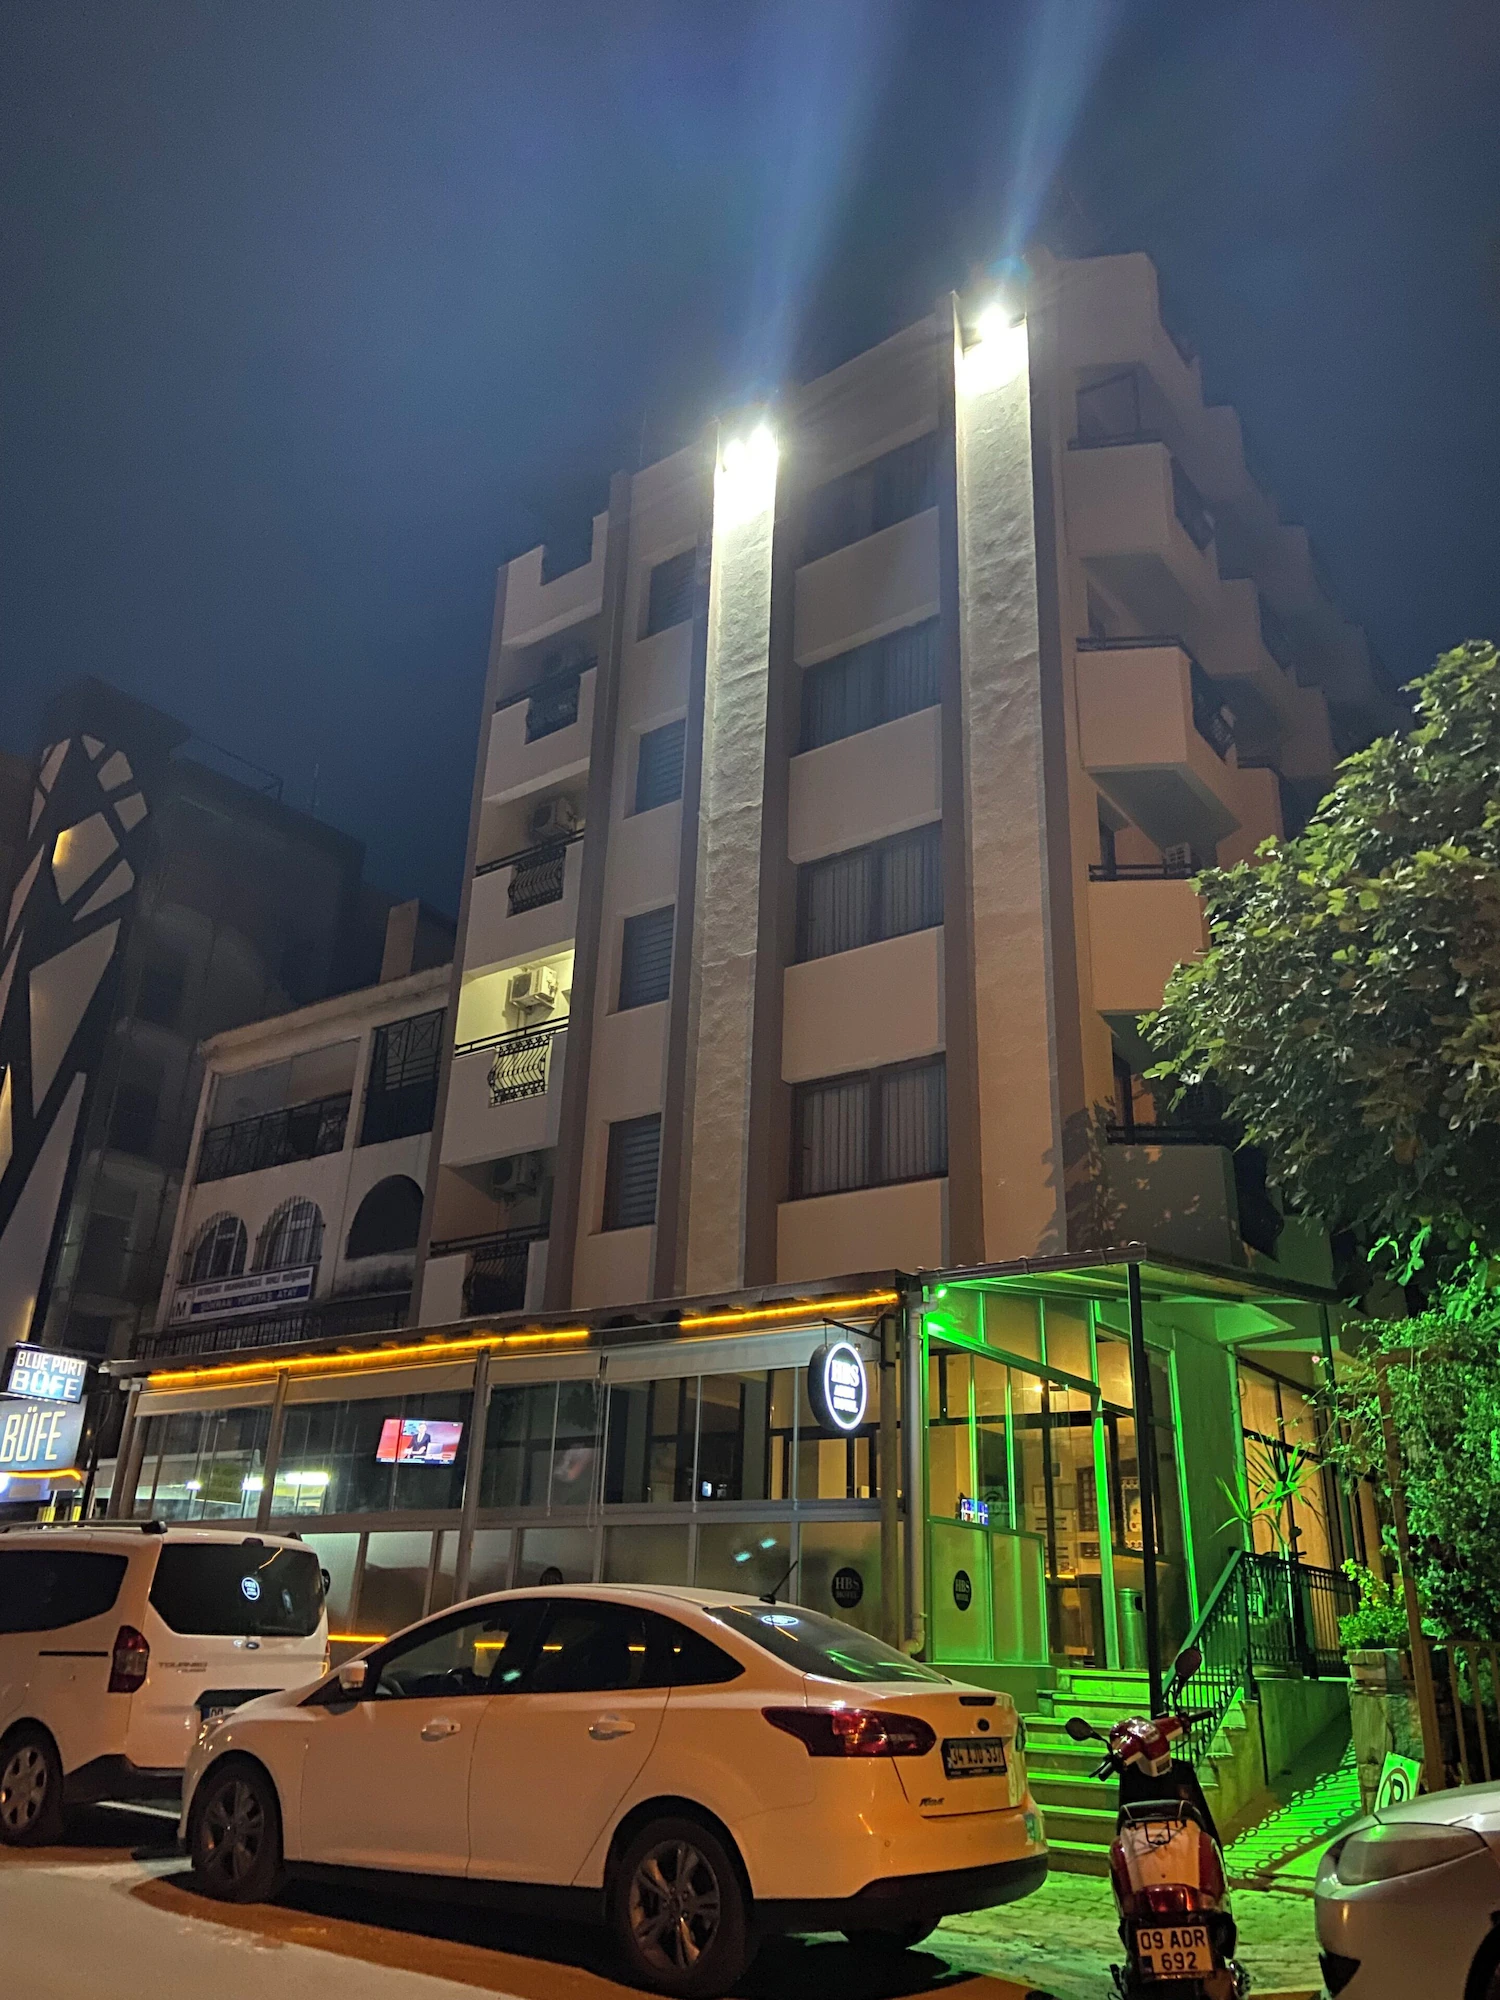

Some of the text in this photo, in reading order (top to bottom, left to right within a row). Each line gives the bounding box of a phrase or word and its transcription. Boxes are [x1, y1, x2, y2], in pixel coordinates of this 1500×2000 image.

[16, 1351, 85, 1377] BLUE PORT
[11, 1369, 80, 1399] BÜFE
[0, 1405, 66, 1463] BÜFE
[835, 1576, 860, 1590] HBS
[1140, 1929, 1205, 1950] 09 ADR
[1161, 1951, 1198, 1971] 692
